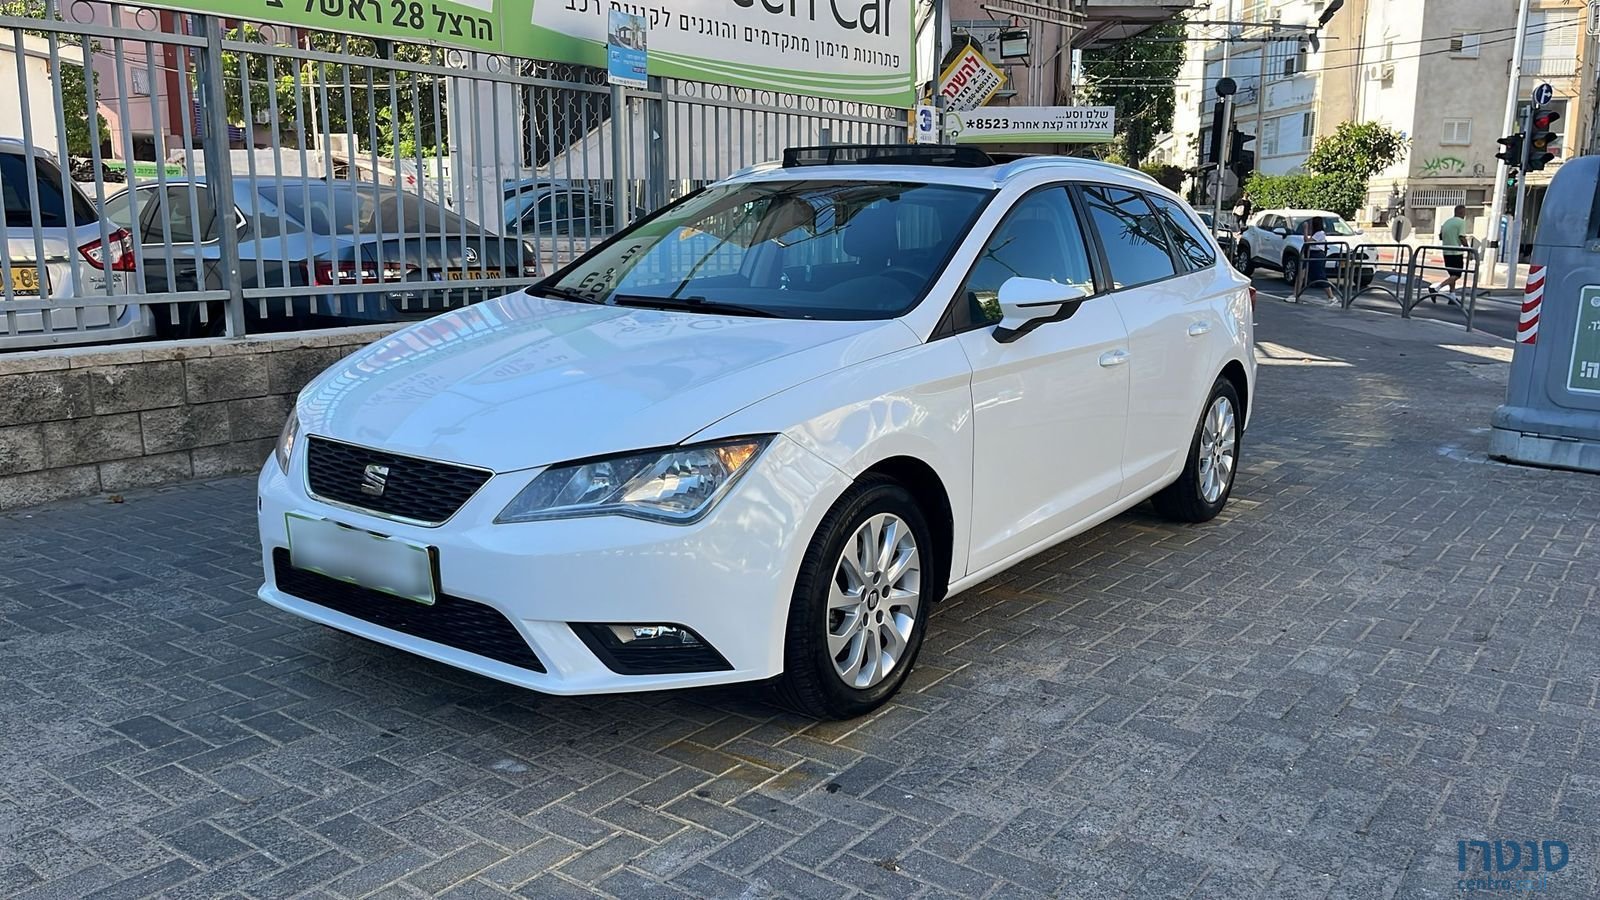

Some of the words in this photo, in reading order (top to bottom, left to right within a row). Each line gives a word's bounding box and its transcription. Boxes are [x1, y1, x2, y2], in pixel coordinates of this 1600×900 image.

[392, 0, 425, 30] 28
[431, 3, 493, 41] הרצל
[680, 14, 737, 40] והוגנים
[744, 27, 810, 53] מתקדמים
[815, 40, 849, 59] מימון
[853, 47, 900, 68] פתרונות
[941, 55, 980, 104] להשכר
[1086, 109, 1109, 119] שלם
[1012, 120, 1040, 129] אחרת
[1042, 120, 1064, 131] קצת
[1066, 120, 1078, 129] זה
[1080, 120, 1109, 129] אצלנו
